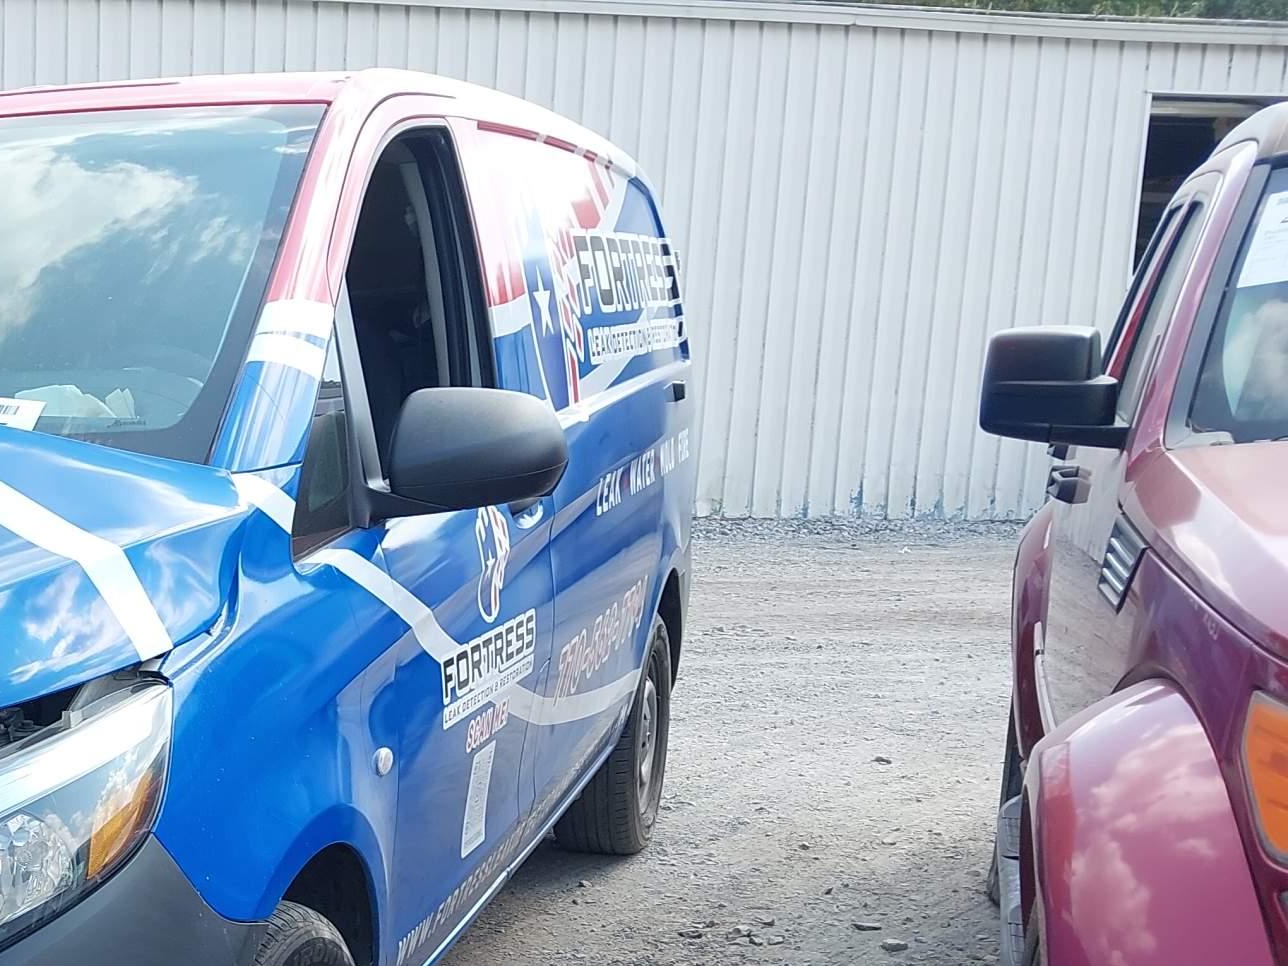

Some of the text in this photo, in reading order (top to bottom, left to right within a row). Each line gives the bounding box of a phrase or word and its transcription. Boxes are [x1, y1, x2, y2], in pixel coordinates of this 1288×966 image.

[596, 466, 624, 517] LEAK
[442, 612, 535, 700] FORTRESS
[444, 704, 461, 724] LEAK
